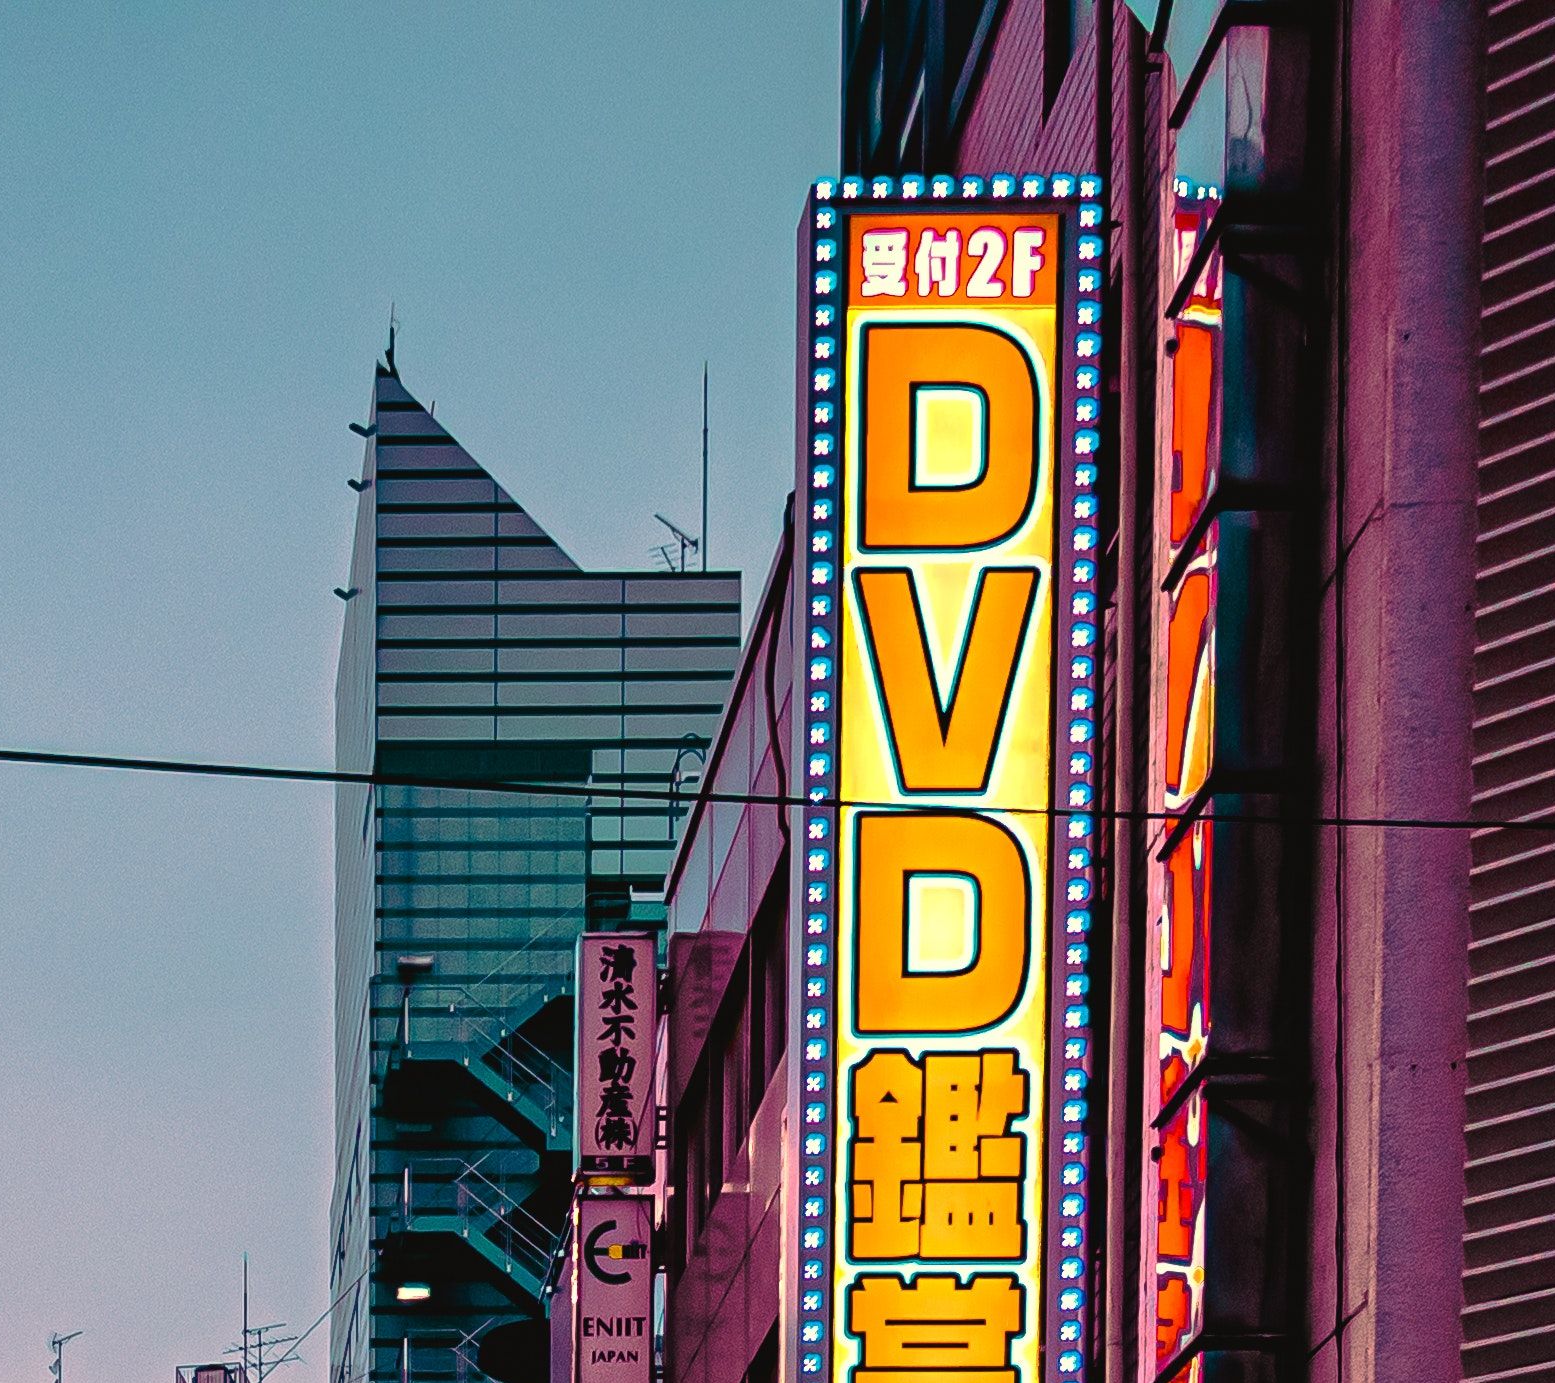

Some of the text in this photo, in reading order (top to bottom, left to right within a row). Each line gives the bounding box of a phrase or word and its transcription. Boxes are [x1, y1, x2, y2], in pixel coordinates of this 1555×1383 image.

[860, 226, 1048, 301] 受付2F
[594, 944, 639, 1152] 清水不動産(株)
[583, 1316, 646, 1337] ENIIT
[590, 1348, 638, 1364] JAPAN
